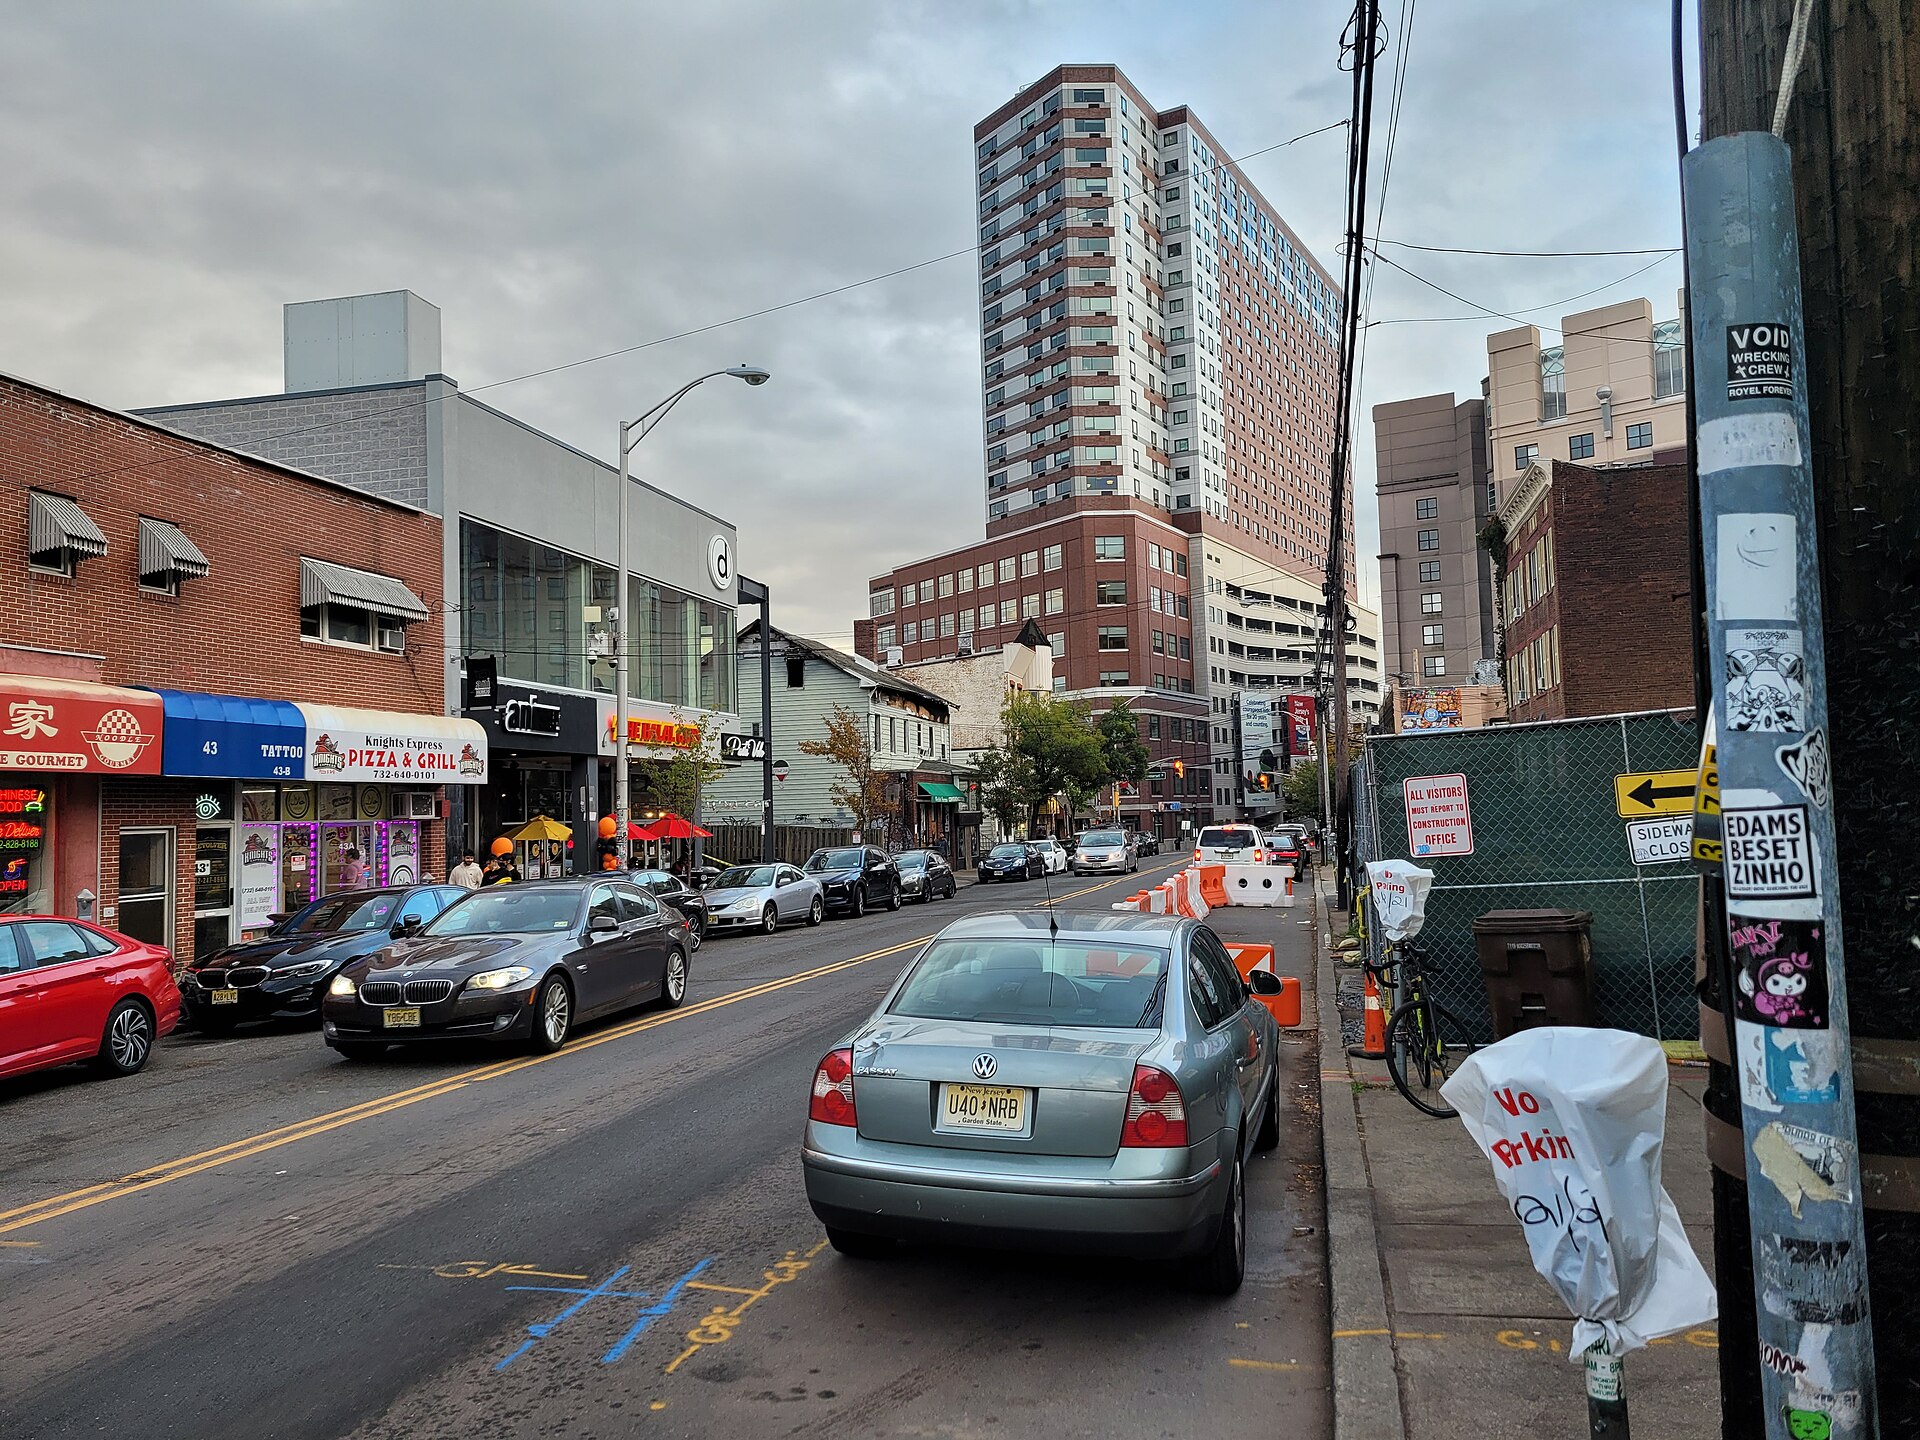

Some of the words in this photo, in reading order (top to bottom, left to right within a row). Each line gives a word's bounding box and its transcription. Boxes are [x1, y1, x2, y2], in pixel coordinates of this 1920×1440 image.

[1731, 327, 1789, 349] VOID
[1731, 351, 1790, 364] WRECKING
[1749, 365, 1783, 375] CREW
[1729, 386, 1761, 397] ROYEL
[95, 734, 142, 743] NOODLE
[365, 735, 404, 749] Knights
[407, 738, 443, 751] Express
[203, 741, 218, 755] 43
[261, 744, 303, 758] TATTOO
[16, 755, 84, 767] GOURMET
[313, 753, 343, 769] KNIGHTS
[348, 749, 398, 768] PIZZA
[402, 752, 412, 768] &
[417, 752, 456, 770] GRILL
[273, 766, 291, 776] 43-B
[374, 770, 435, 780] 732-640-0101
[0, 790, 38, 800] HINESE
[1410, 790, 1424, 801] ALL
[1426, 786, 1463, 800] VISITORS
[0, 802, 22, 812] OOD
[1411, 806, 1428, 815] MUST
[1431, 804, 1454, 814] REPORT
[1456, 803, 1464, 812] TO
[1413, 817, 1466, 830] CONSTRUCTION
[1727, 812, 1800, 838] EDAMS
[1637, 823, 1693, 841] SIDEWA
[1425, 833, 1457, 845] OFFICE
[338, 842, 355, 850] 43A
[1649, 841, 1690, 857] CLOS
[1730, 837, 1800, 861] BESET
[1733, 861, 1804, 884] ZINHO
[856, 1066, 898, 1077] PASSAT
[965, 1086, 983, 1096] New
[983, 1087, 1006, 1097] Jersey
[950, 1094, 978, 1116] U40
[988, 1097, 1018, 1119] NRB
[962, 1117, 984, 1125] Garden
[985, 1119, 1003, 1127] State
